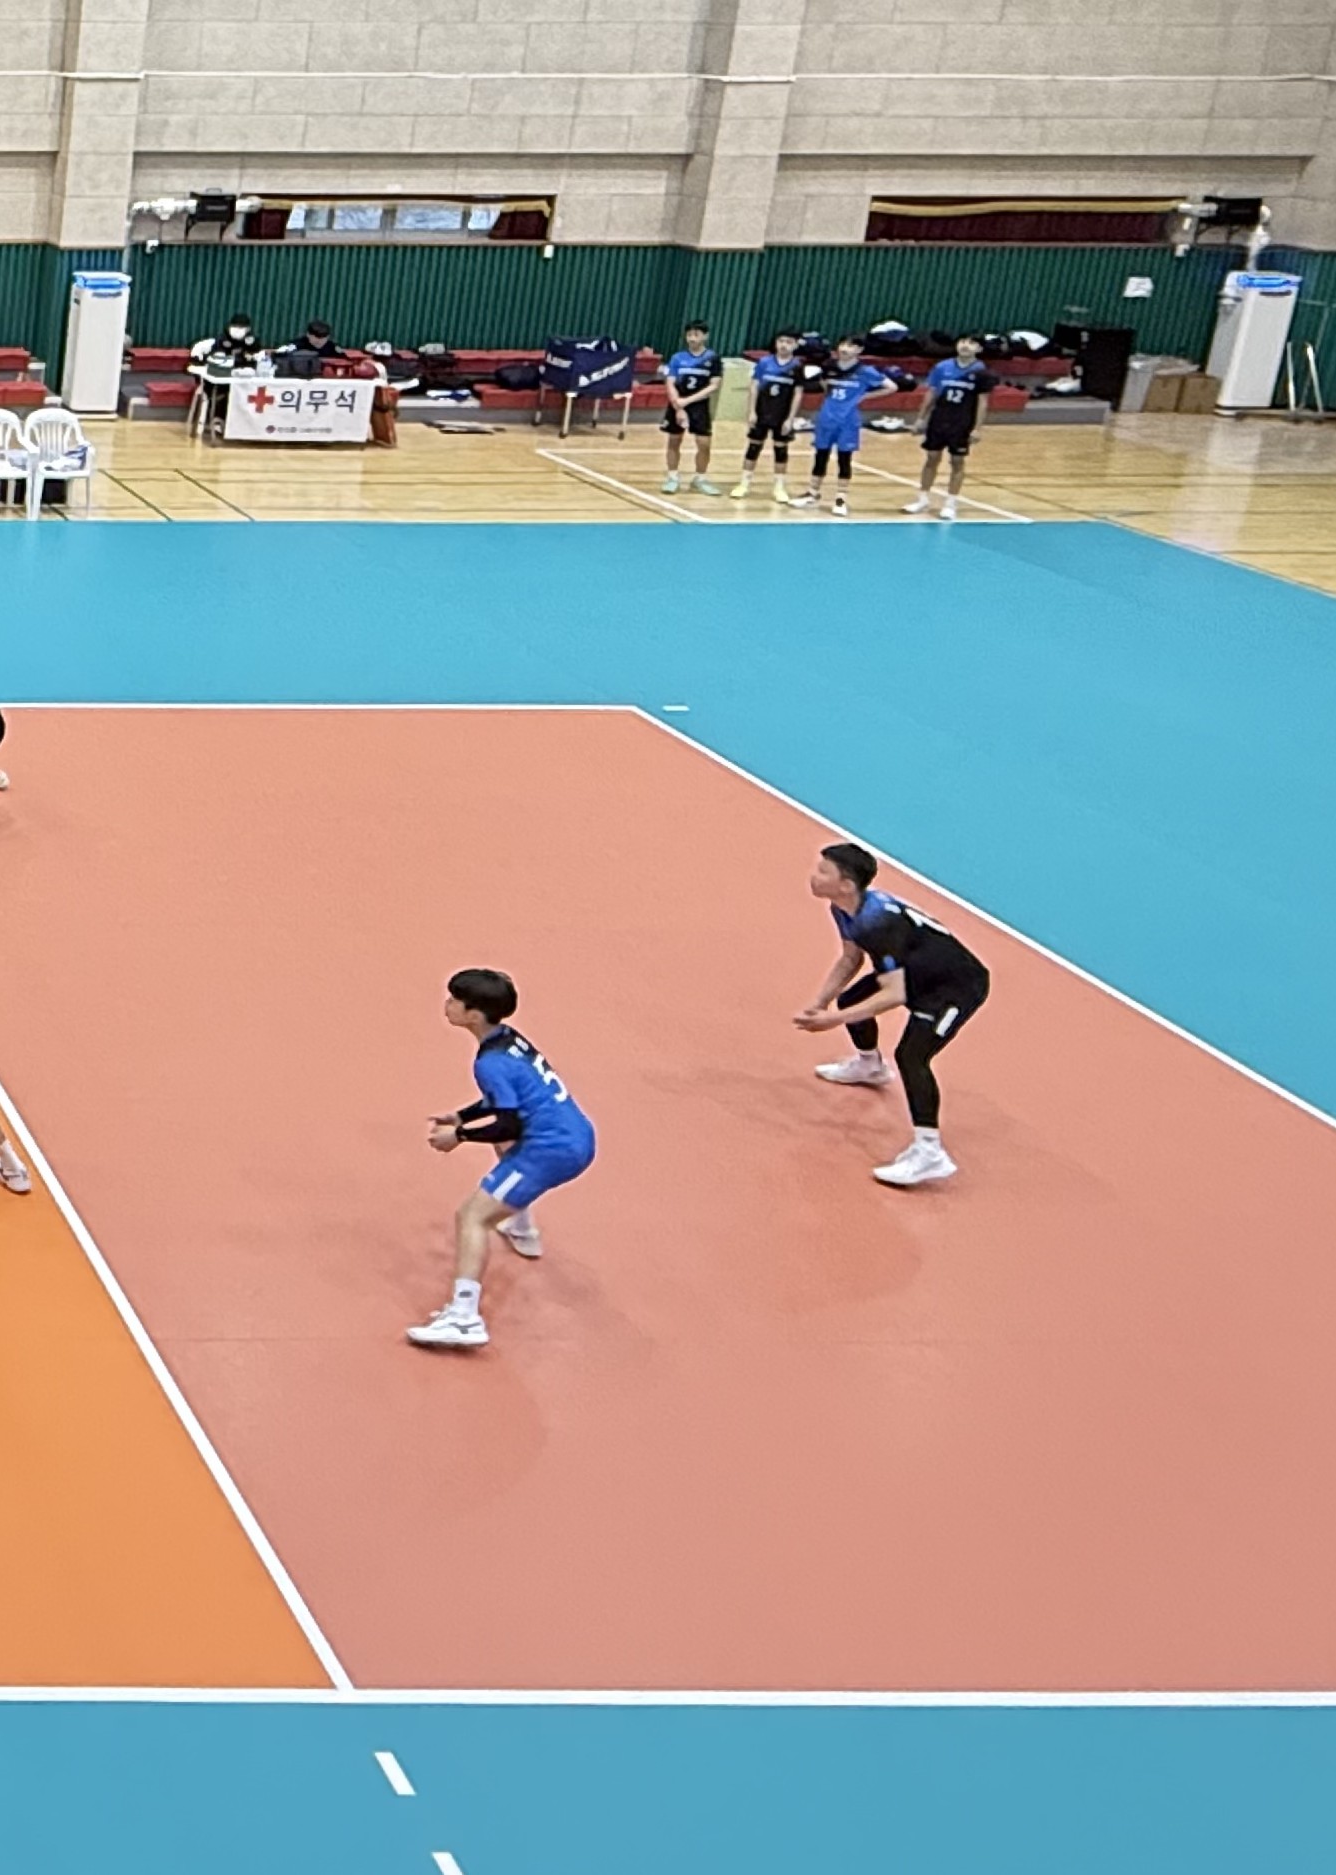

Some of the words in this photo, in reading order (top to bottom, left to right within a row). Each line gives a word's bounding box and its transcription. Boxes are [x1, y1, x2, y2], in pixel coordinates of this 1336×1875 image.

[687, 376, 698, 389] 2
[278, 389, 357, 414] 의무석
[946, 389, 965, 403] 12
[531, 1053, 568, 1103] 5
